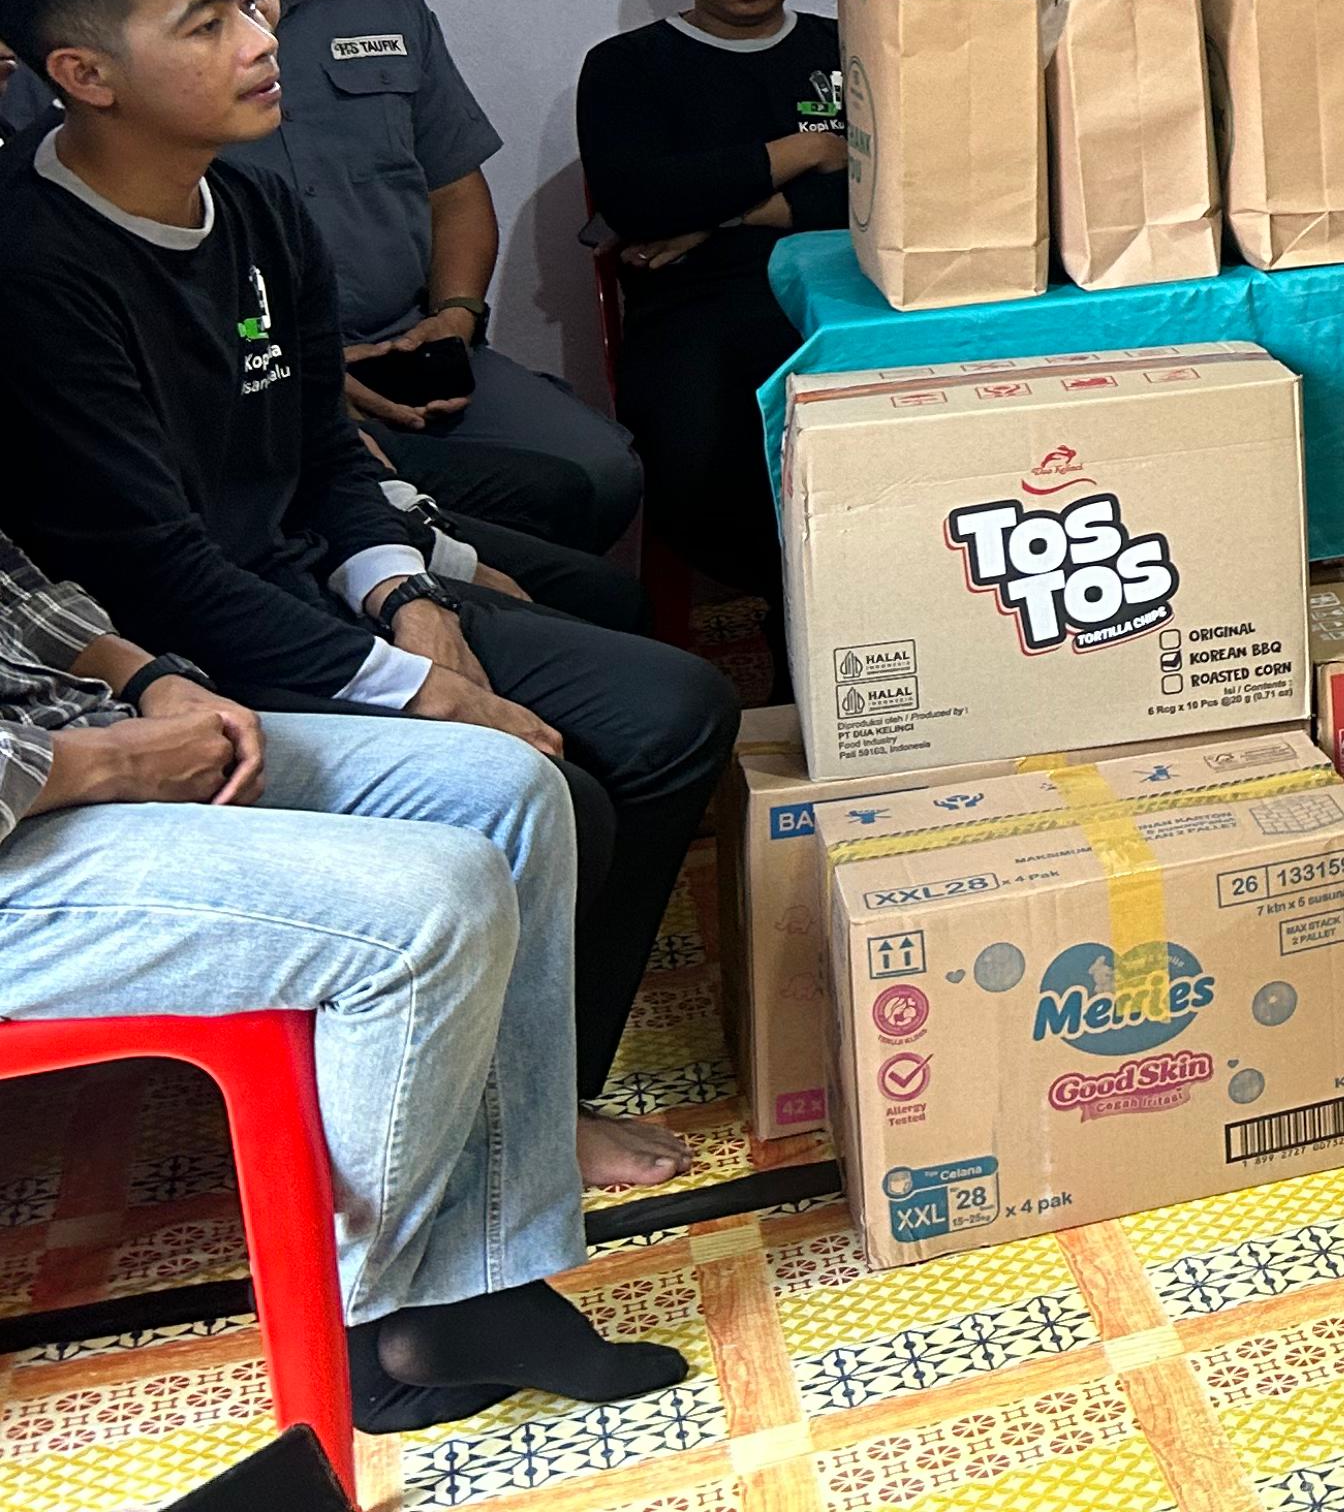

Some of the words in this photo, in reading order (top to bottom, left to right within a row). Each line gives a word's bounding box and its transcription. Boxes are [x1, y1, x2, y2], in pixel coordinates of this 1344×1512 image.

[360, 39, 402, 54] TAUFIK
[799, 119, 827, 133] Kopi
[1077, 620, 1133, 646] TORTILLA
[1133, 605, 1168, 628] CHIPS
[1188, 623, 1256, 642] ORIGINAL
[866, 651, 911, 664] HALAL
[1189, 646, 1247, 665] KOREAN
[1252, 641, 1282, 657] BBQ
[1191, 667, 1249, 687] ROASTED
[1254, 661, 1292, 677] CORN
[868, 687, 913, 700] HALAL
[1223, 685, 1236, 695] Isi
[1244, 680, 1287, 692] Contents
[1187, 701, 1198, 709] 10
[910, 708, 951, 721] Produced
[838, 731, 851, 740] PT
[852, 729, 874, 738] DUA
[876, 723, 914, 735] KELINCI
[838, 741, 864, 750] Food
[863, 736, 897, 747] Industry
[889, 740, 931, 753] Indonesia
[779, 812, 814, 832] BA
[1015, 846, 1093, 864] MAKSIMUM
[875, 877, 989, 906] XXL28
[1028, 869, 1060, 881] Pak
[1232, 875, 1259, 896] 26
[1256, 906, 1264, 916] 7
[1267, 901, 1286, 914] ktn
[1288, 901, 1295, 910] x
[1286, 923, 1307, 935] MAX
[1308, 915, 1341, 931] STACK
[1300, 928, 1336, 943] PALLET
[1033, 976, 1215, 1041] Merries
[1055, 1066, 1135, 1103] Good
[1138, 1053, 1207, 1087] Skin
[886, 1103, 927, 1116] Allergy
[1096, 1098, 1138, 1112] Cegah
[889, 1113, 926, 1126] Tested
[940, 1165, 983, 1180] Celana
[956, 1186, 987, 1211] 28
[1005, 1206, 1016, 1217] x
[1020, 1199, 1032, 1213] 4
[1038, 1192, 1073, 1213] pak
[896, 1203, 946, 1231] XXL
